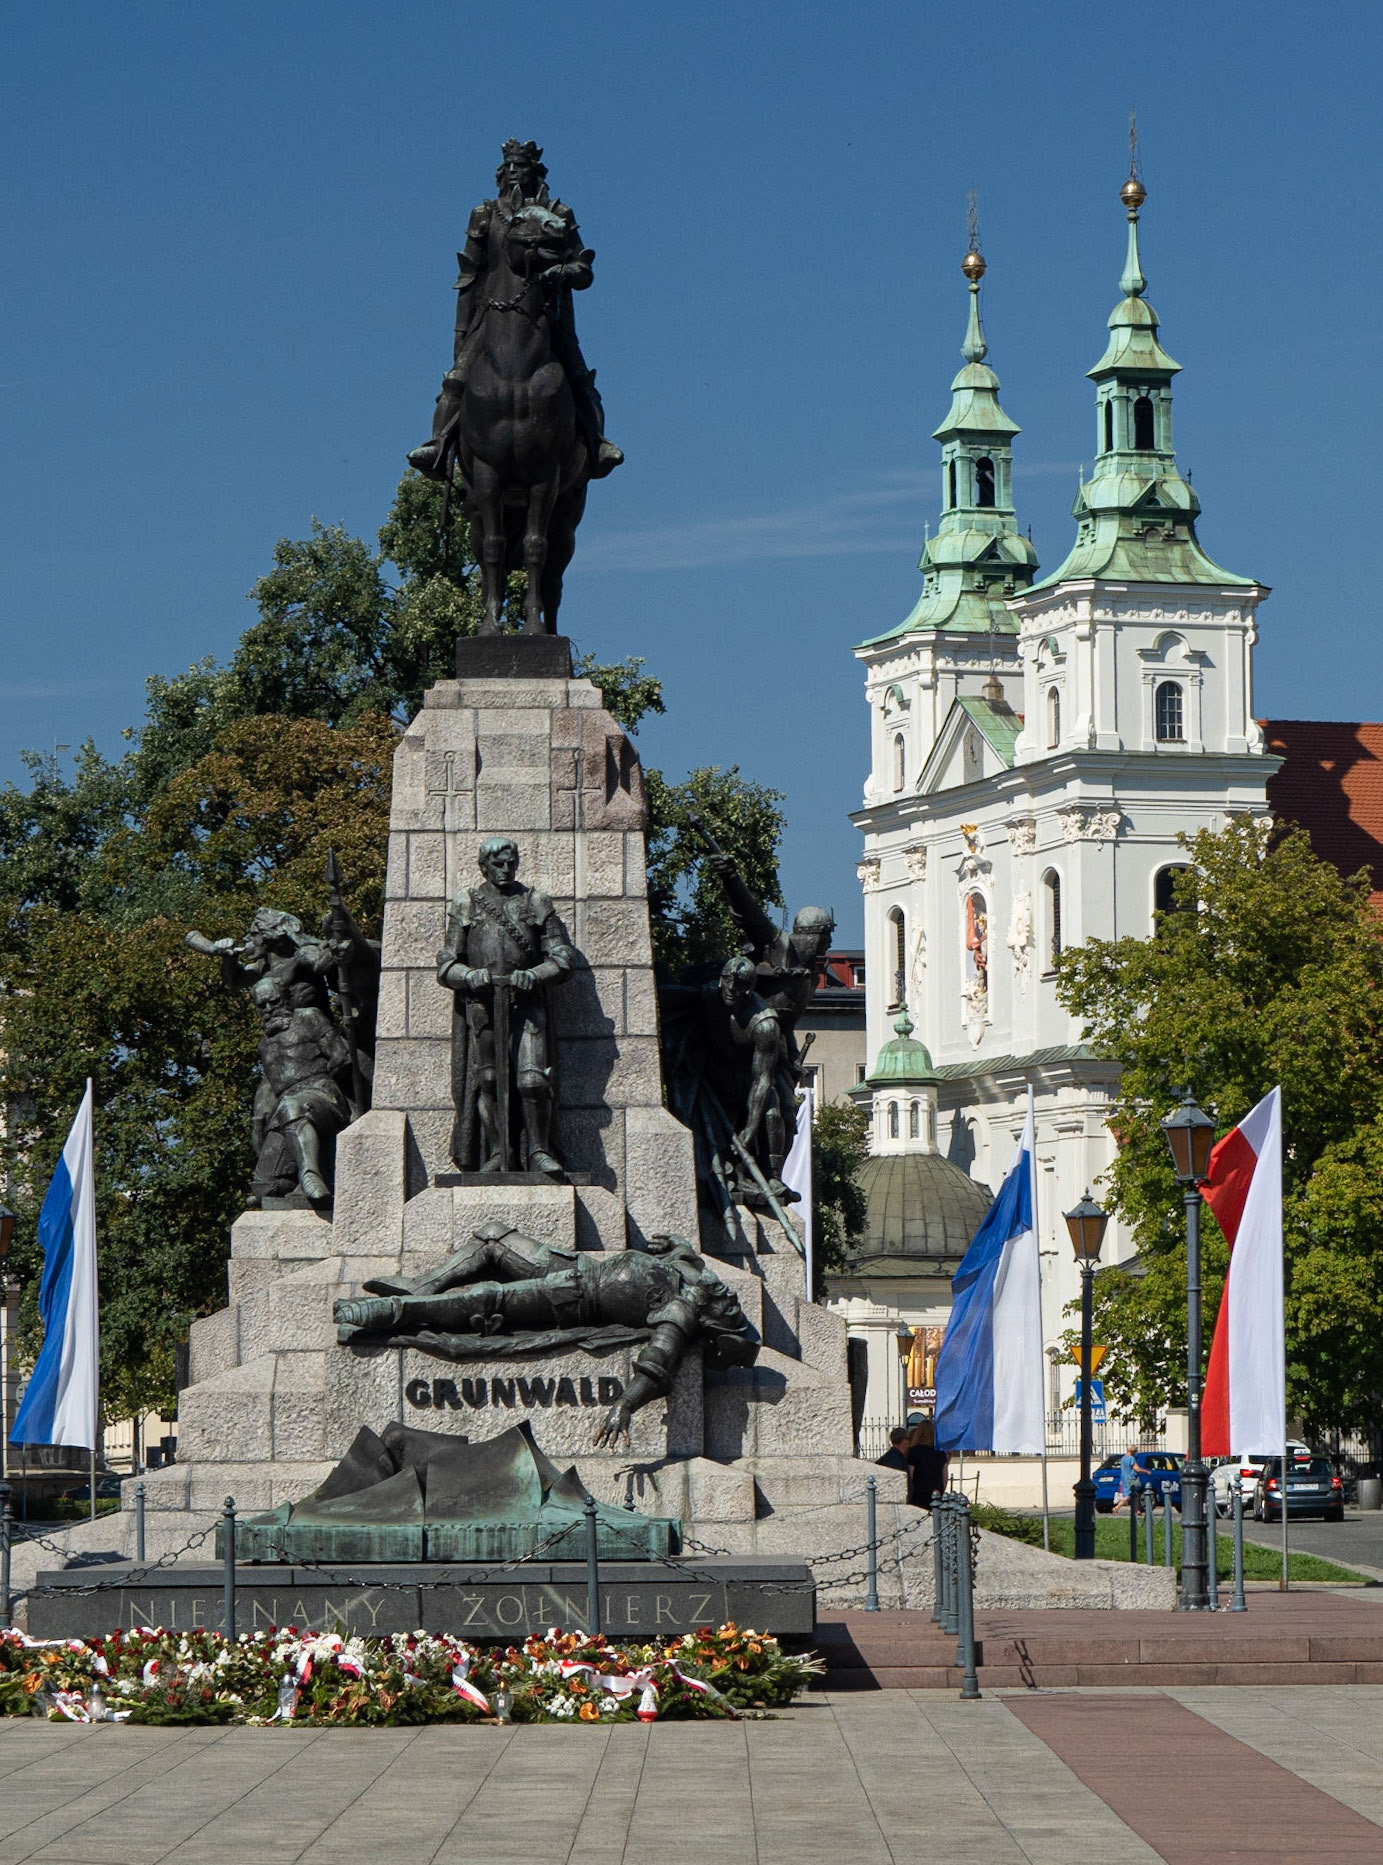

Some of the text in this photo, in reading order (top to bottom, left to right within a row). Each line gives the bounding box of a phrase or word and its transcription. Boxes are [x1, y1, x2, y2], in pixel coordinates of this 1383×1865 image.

[405, 1377, 624, 1409] GRUNWALD
[909, 1389, 937, 1398] CAŁOD
[129, 1593, 716, 1628] NIEZNANY ŻOŁNIERZ
